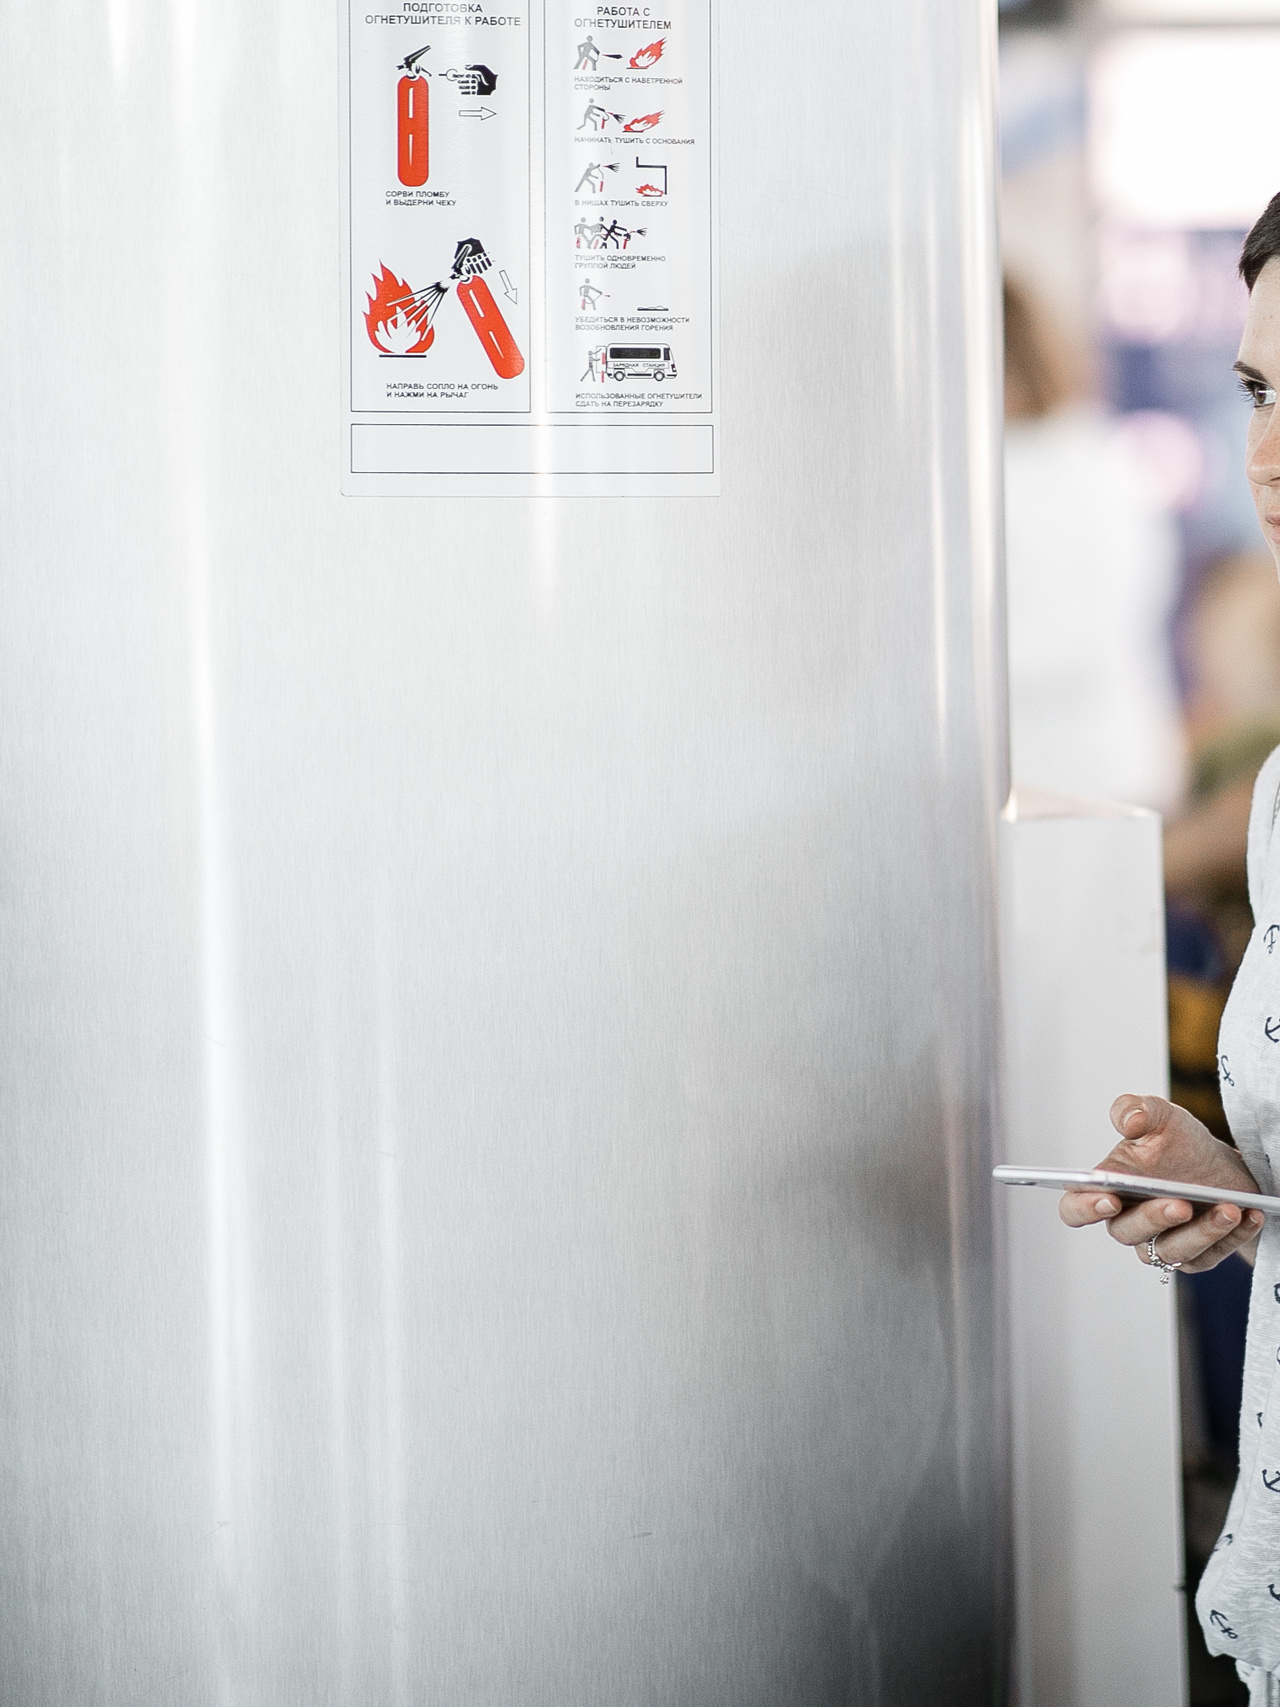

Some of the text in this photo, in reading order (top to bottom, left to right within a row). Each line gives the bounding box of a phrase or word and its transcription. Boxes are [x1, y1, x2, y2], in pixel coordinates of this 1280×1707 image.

[403, 3, 483, 14] ПОДГОТОВКА
[597, 6, 640, 16] РАБОТА
[365, 15, 521, 26] ОГНЕТУШИТЕЛЯ К РАБОТЕ
[574, 18, 672, 30] ОГНЕТУШИТЕЛЕМ
